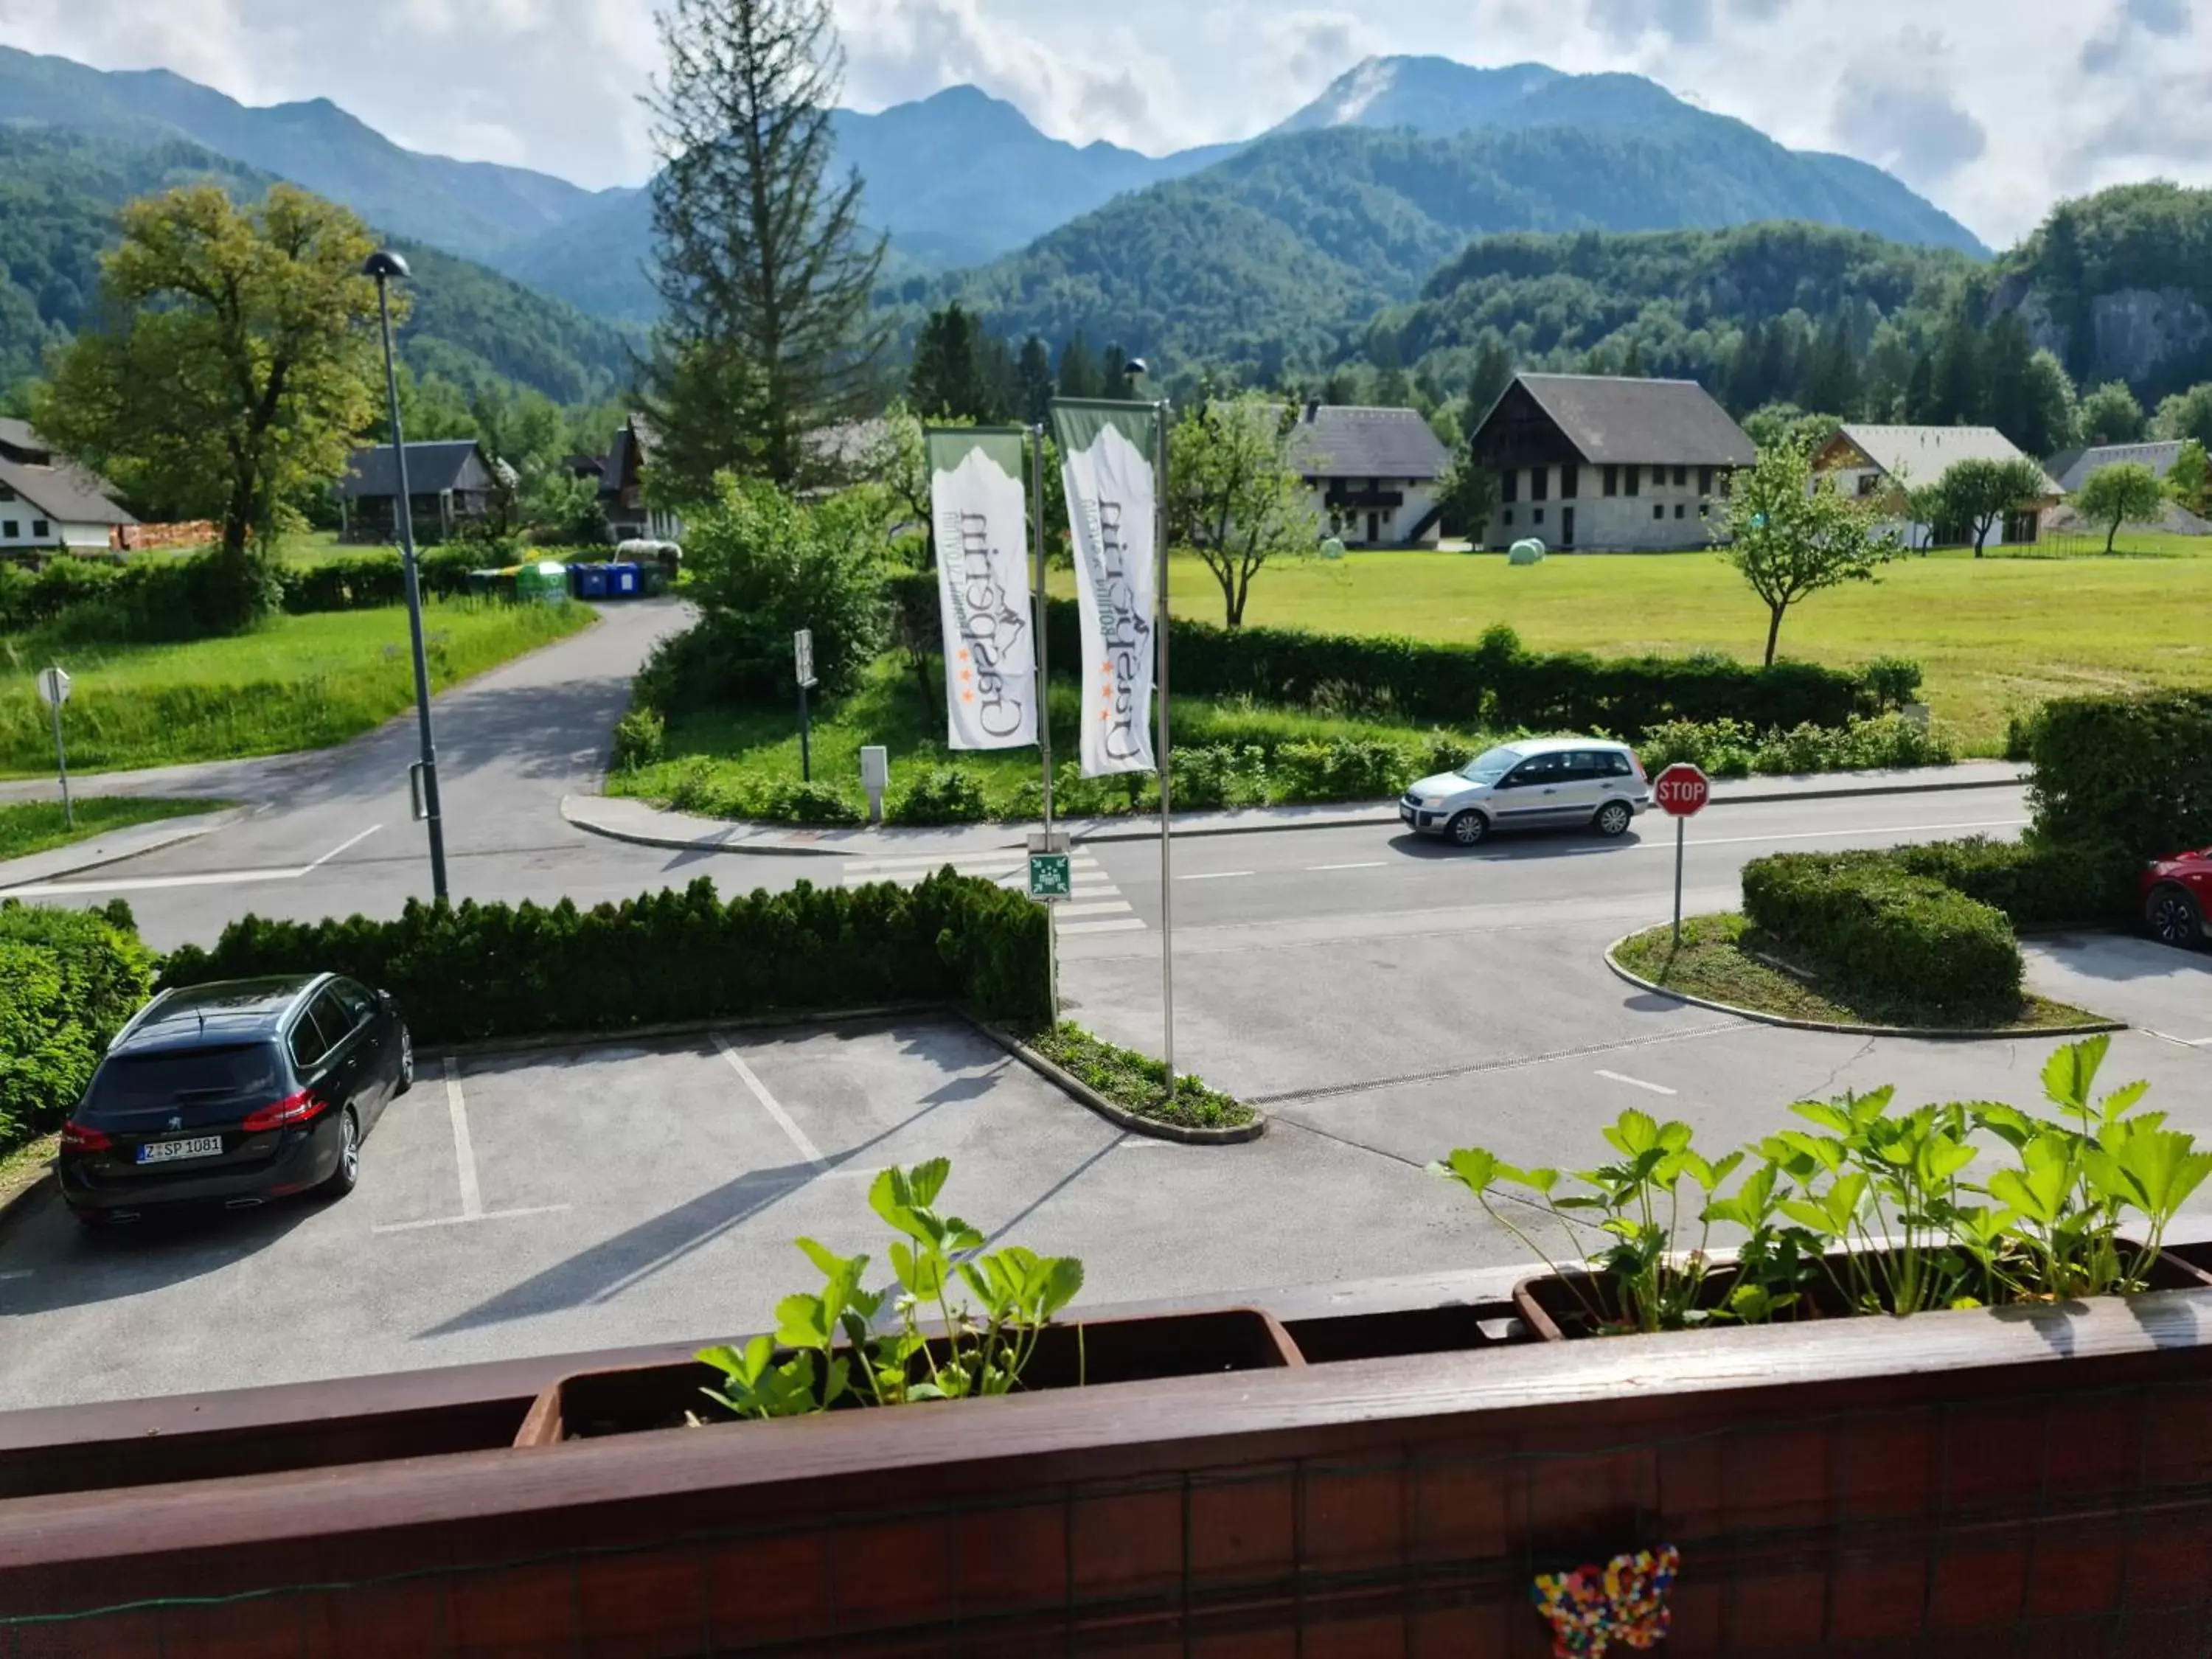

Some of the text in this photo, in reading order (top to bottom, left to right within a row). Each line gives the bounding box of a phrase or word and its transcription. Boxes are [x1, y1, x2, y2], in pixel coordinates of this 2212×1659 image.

[1659, 782, 1705, 801] STOP
[164, 1142, 182, 1155] SP
[186, 1138, 219, 1153] 1081
